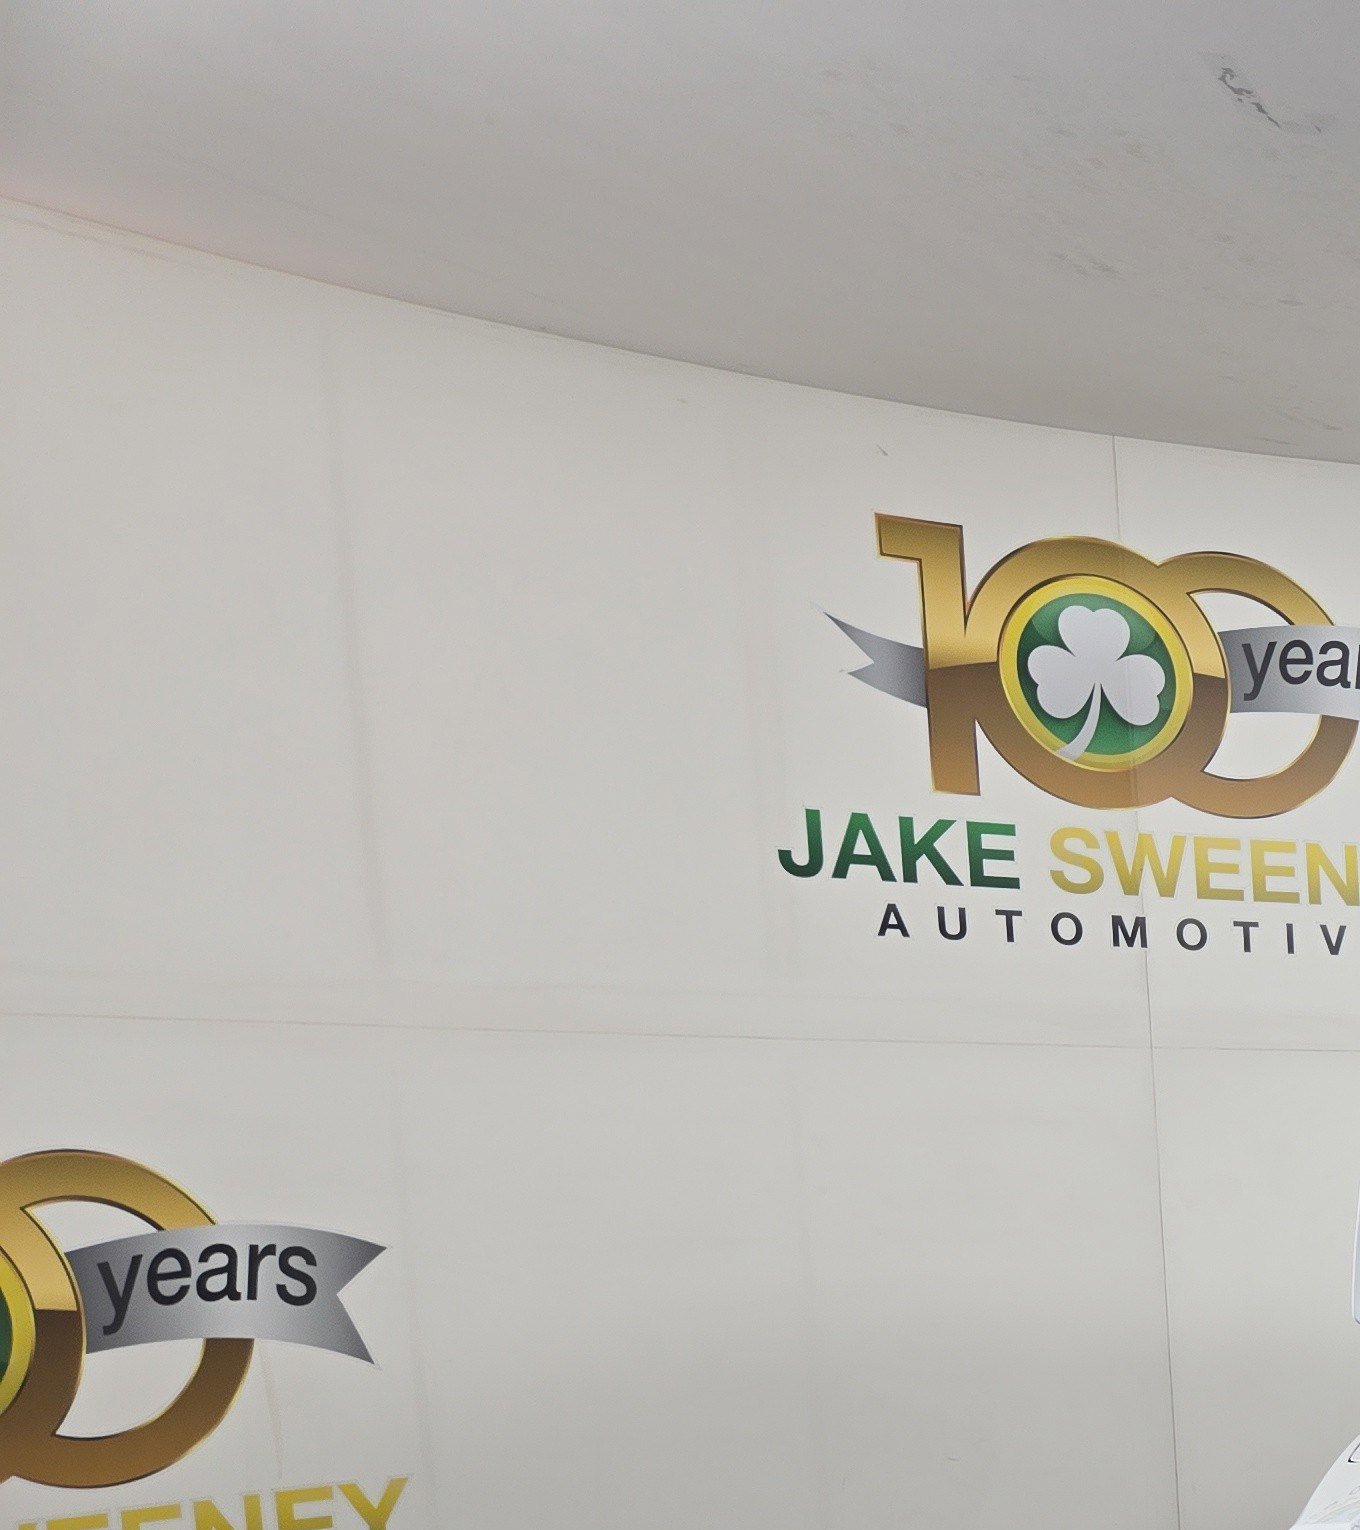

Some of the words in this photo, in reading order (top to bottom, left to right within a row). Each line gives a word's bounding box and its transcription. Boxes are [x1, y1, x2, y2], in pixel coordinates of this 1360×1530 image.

[873, 511, 1360, 820] 100
[776, 806, 1022, 890] JAKE
[96, 1242, 319, 1336] years
